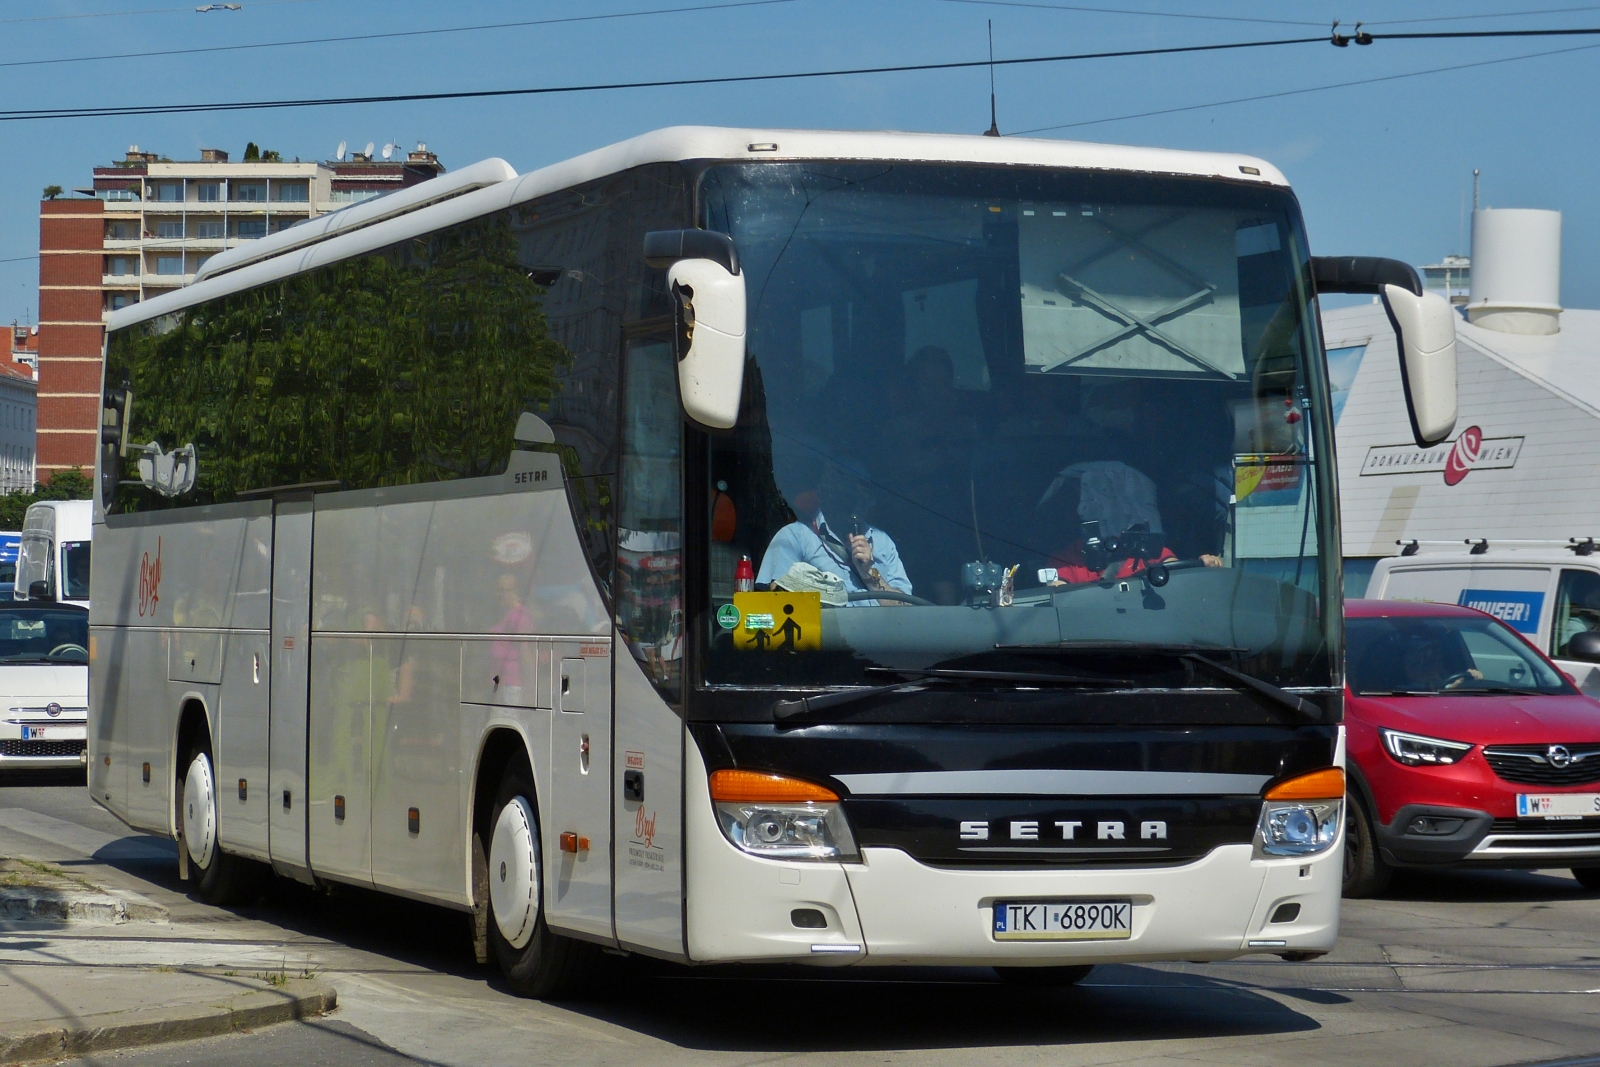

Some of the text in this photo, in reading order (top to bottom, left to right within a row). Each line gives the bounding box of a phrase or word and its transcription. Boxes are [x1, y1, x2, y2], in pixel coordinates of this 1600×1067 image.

[1370, 447, 1514, 467] DONAURAUM WIEN
[514, 470, 548, 484] SETRA
[725, 605, 732, 616] 4
[30, 728, 38, 738] W
[1530, 798, 1540, 813] W
[959, 821, 1168, 840] SETRA
[996, 921, 1006, 929] PL
[1009, 905, 1127, 931] TKI 6890K
